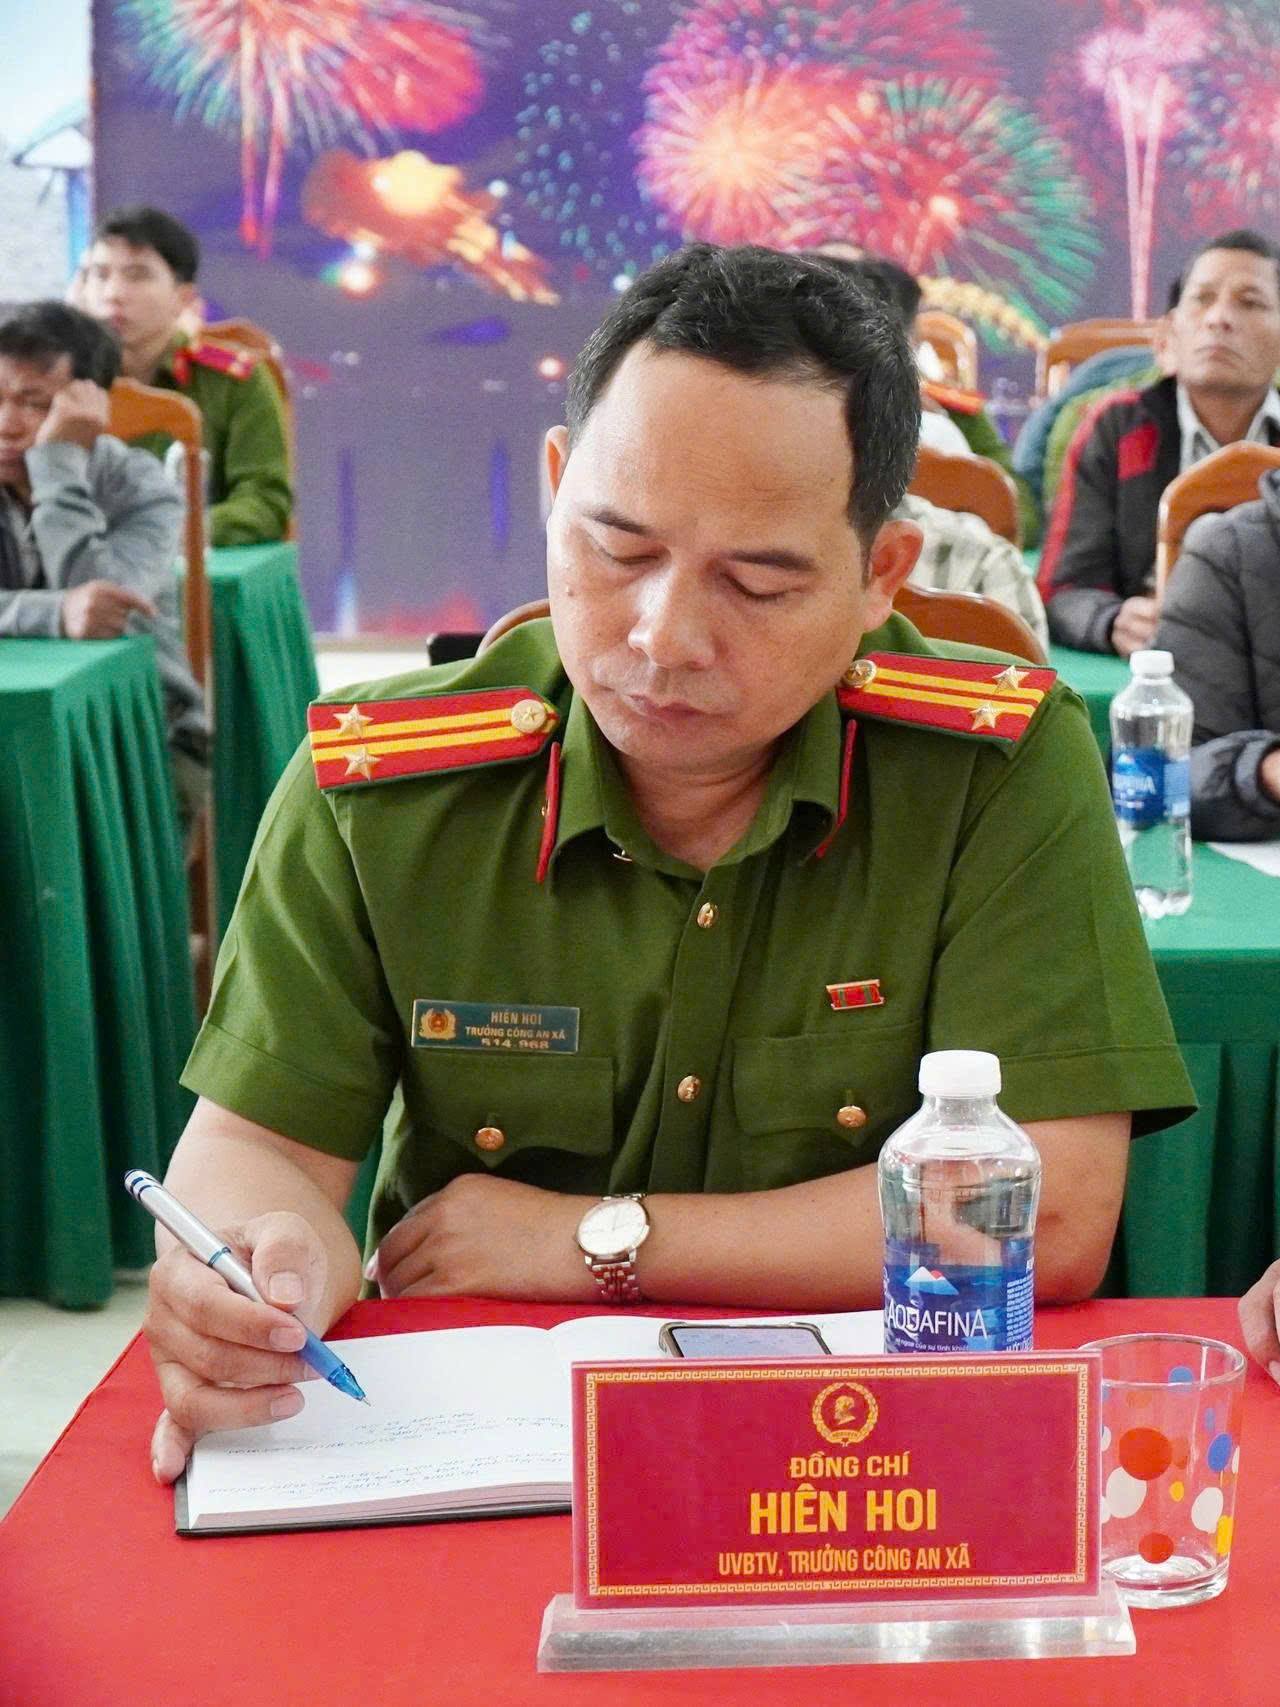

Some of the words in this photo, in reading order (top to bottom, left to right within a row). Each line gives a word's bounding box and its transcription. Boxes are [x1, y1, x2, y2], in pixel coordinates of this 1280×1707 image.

[535, 1029, 550, 1039] AN
[887, 1298, 988, 1340] AQUAFINA
[790, 1451, 859, 1478] ĐỒNG
[866, 1451, 911, 1478] CHÍ
[750, 1483, 847, 1535] HIÊN
[866, 1488, 937, 1532] HOI
[719, 1551, 784, 1576] UVBTV,
[788, 1543, 859, 1575] TRƯỞNG
[863, 1544, 912, 1572] CÔNG
[915, 1547, 941, 1571] AN
[945, 1542, 970, 1570] XÃ
